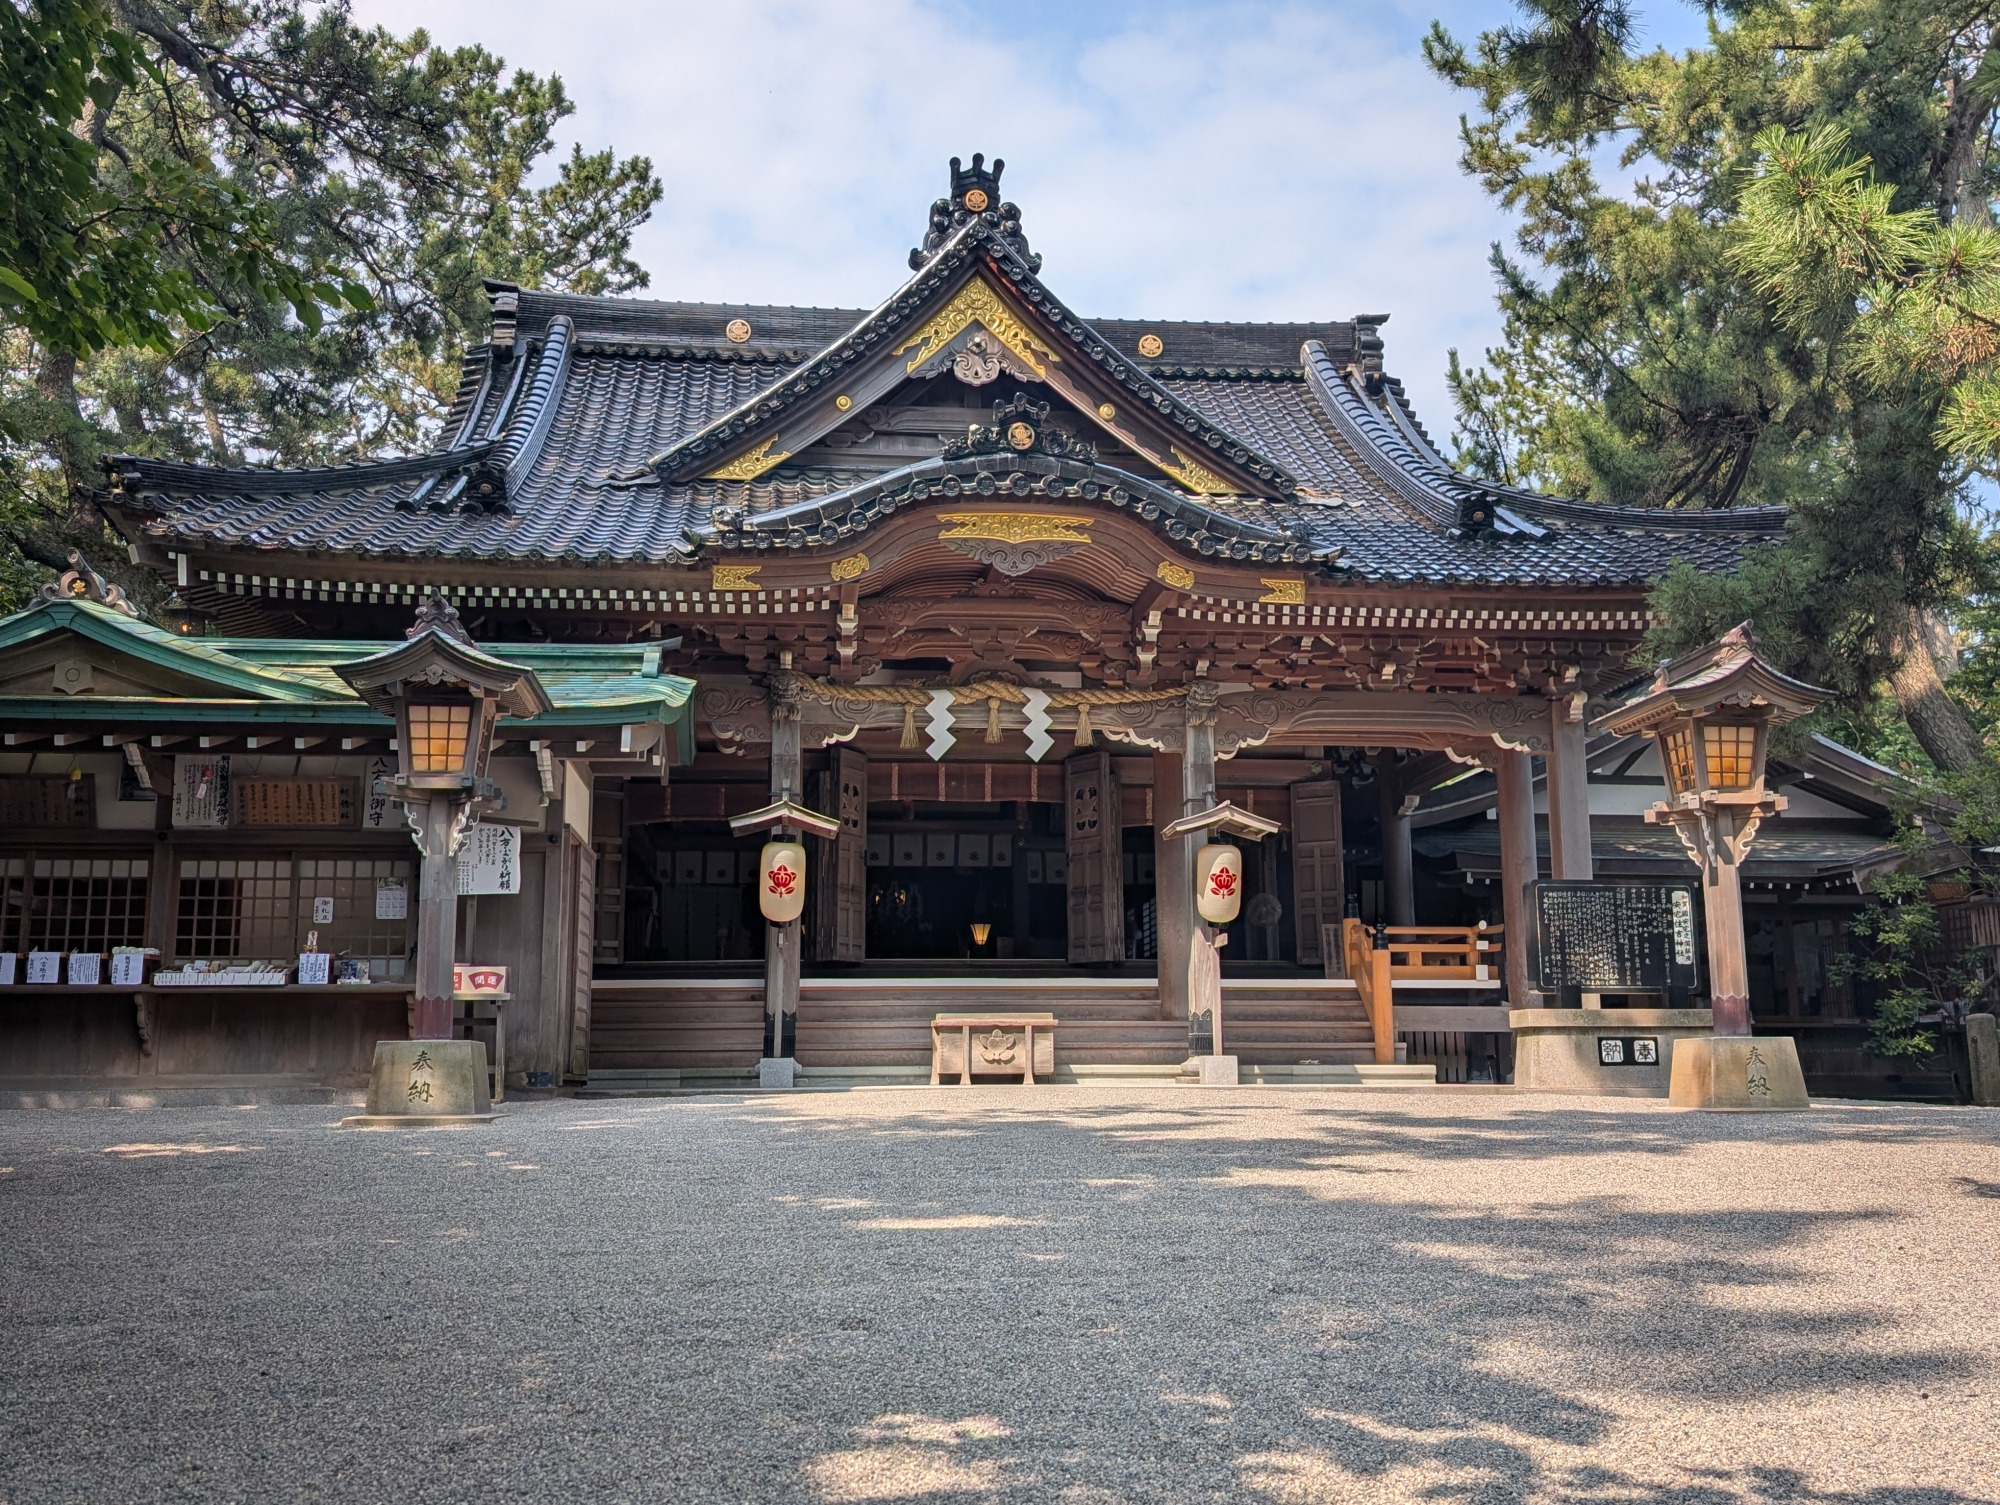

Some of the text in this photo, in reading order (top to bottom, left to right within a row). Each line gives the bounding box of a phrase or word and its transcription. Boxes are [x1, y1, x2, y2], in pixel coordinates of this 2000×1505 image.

[1673, 901, 1686, 957] 安宅住吉神社
[474, 975, 498, 985] 開運
[408, 1050, 434, 1103] 奉納
[1746, 1046, 1772, 1096] 奉納
